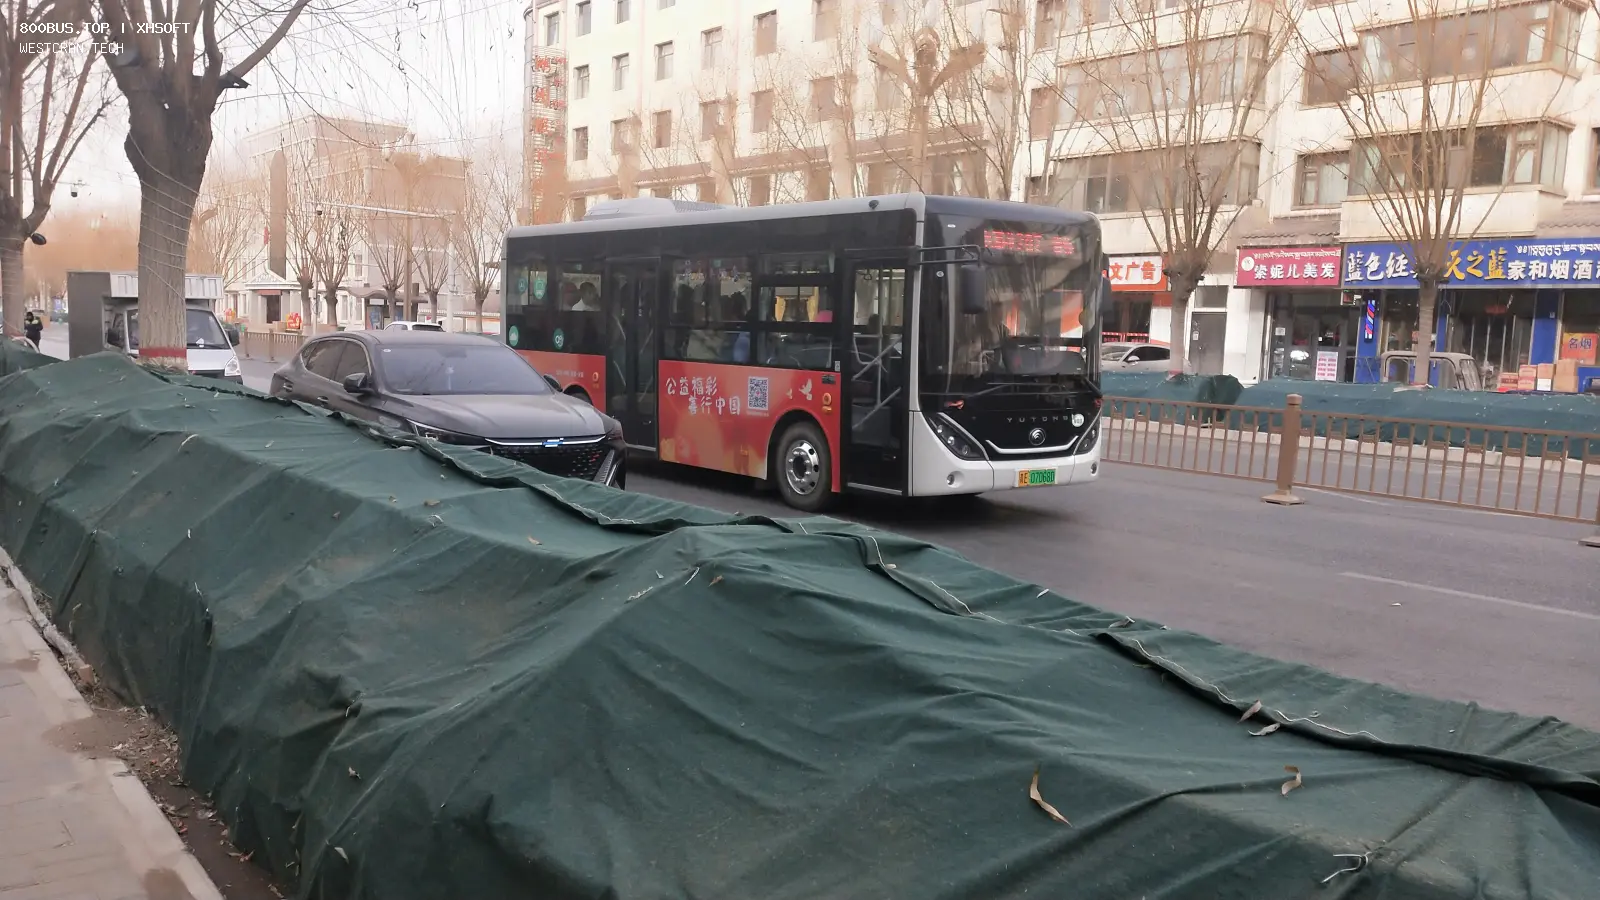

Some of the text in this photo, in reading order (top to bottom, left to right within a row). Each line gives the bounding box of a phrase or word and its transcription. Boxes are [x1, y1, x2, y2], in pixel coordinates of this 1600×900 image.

[1507, 259, 1600, 280] 家和烟酒
[665, 376, 718, 397] 公益福彩
